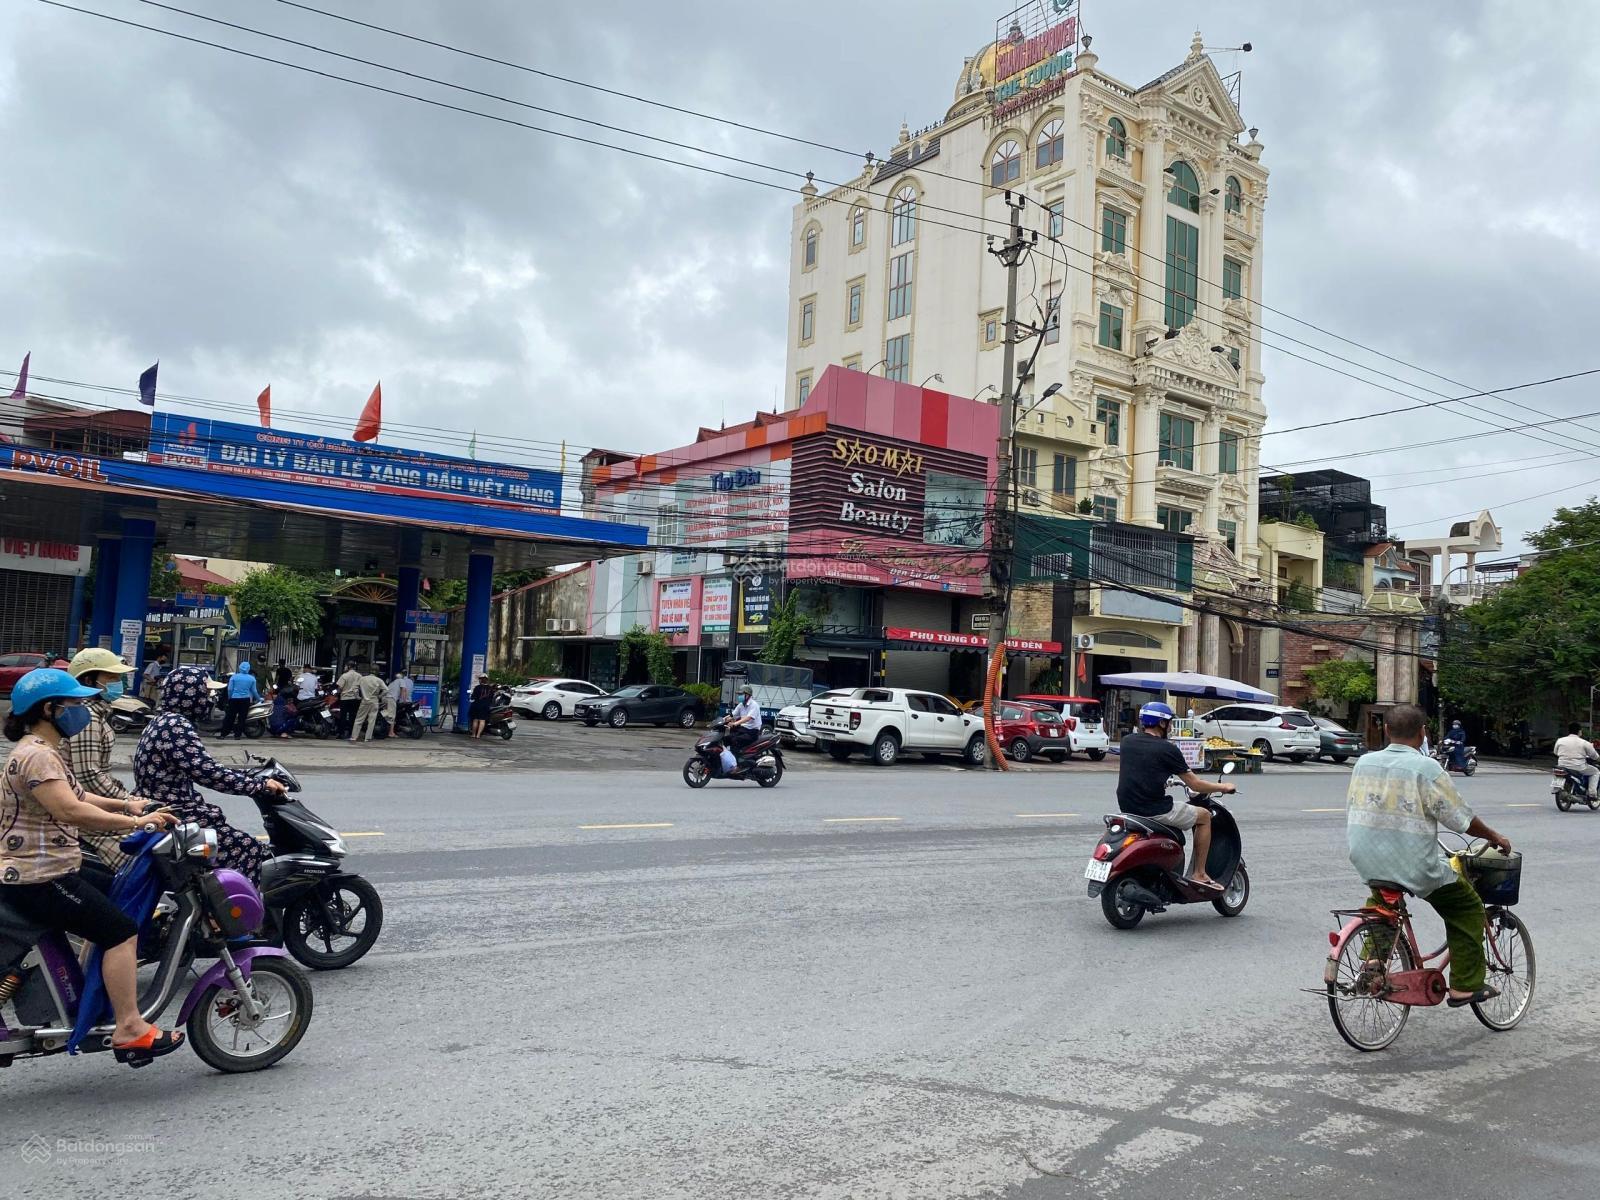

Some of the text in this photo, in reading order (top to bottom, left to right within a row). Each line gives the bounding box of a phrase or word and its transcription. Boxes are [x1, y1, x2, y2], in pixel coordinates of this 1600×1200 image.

[12, 449, 108, 482] PVOIL
[221, 444, 258, 466] ĐẠI
[263, 447, 288, 468] LÝ
[293, 452, 336, 474] BÁN
[468, 478, 505, 498] VIỆT
[508, 484, 554, 504] HÙNG
[847, 472, 906, 501] Salon
[839, 502, 912, 534] Beauty
[909, 631, 934, 643] PHỤ
[937, 633, 968, 644] TÙNG
[970, 635, 979, 645] Ô
[1021, 640, 1043, 650] ĐÈN
[811, 719, 849, 728] RANGER
